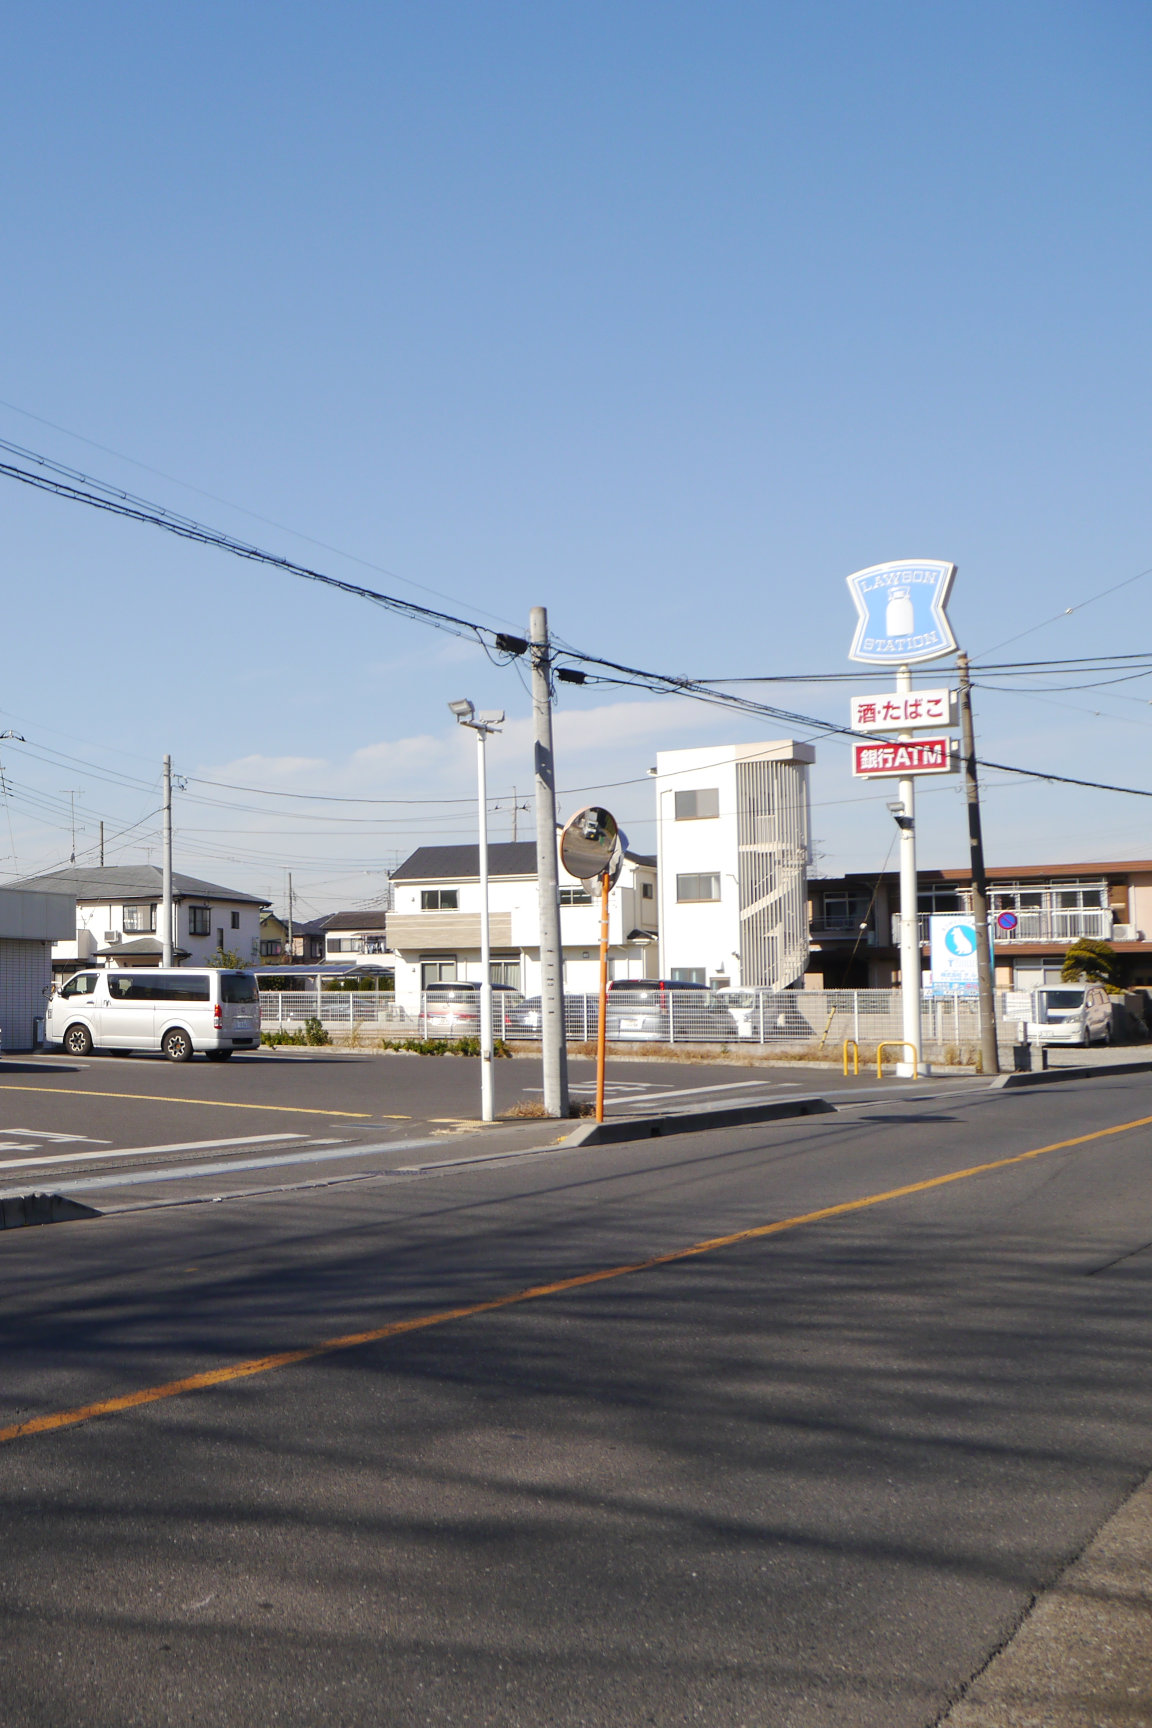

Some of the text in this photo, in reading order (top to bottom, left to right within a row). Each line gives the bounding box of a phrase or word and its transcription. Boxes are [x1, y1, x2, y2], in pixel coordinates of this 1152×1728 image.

[861, 571, 938, 593] LAWSON
[863, 631, 939, 652] STATION
[860, 744, 943, 769] 銀行ATM
